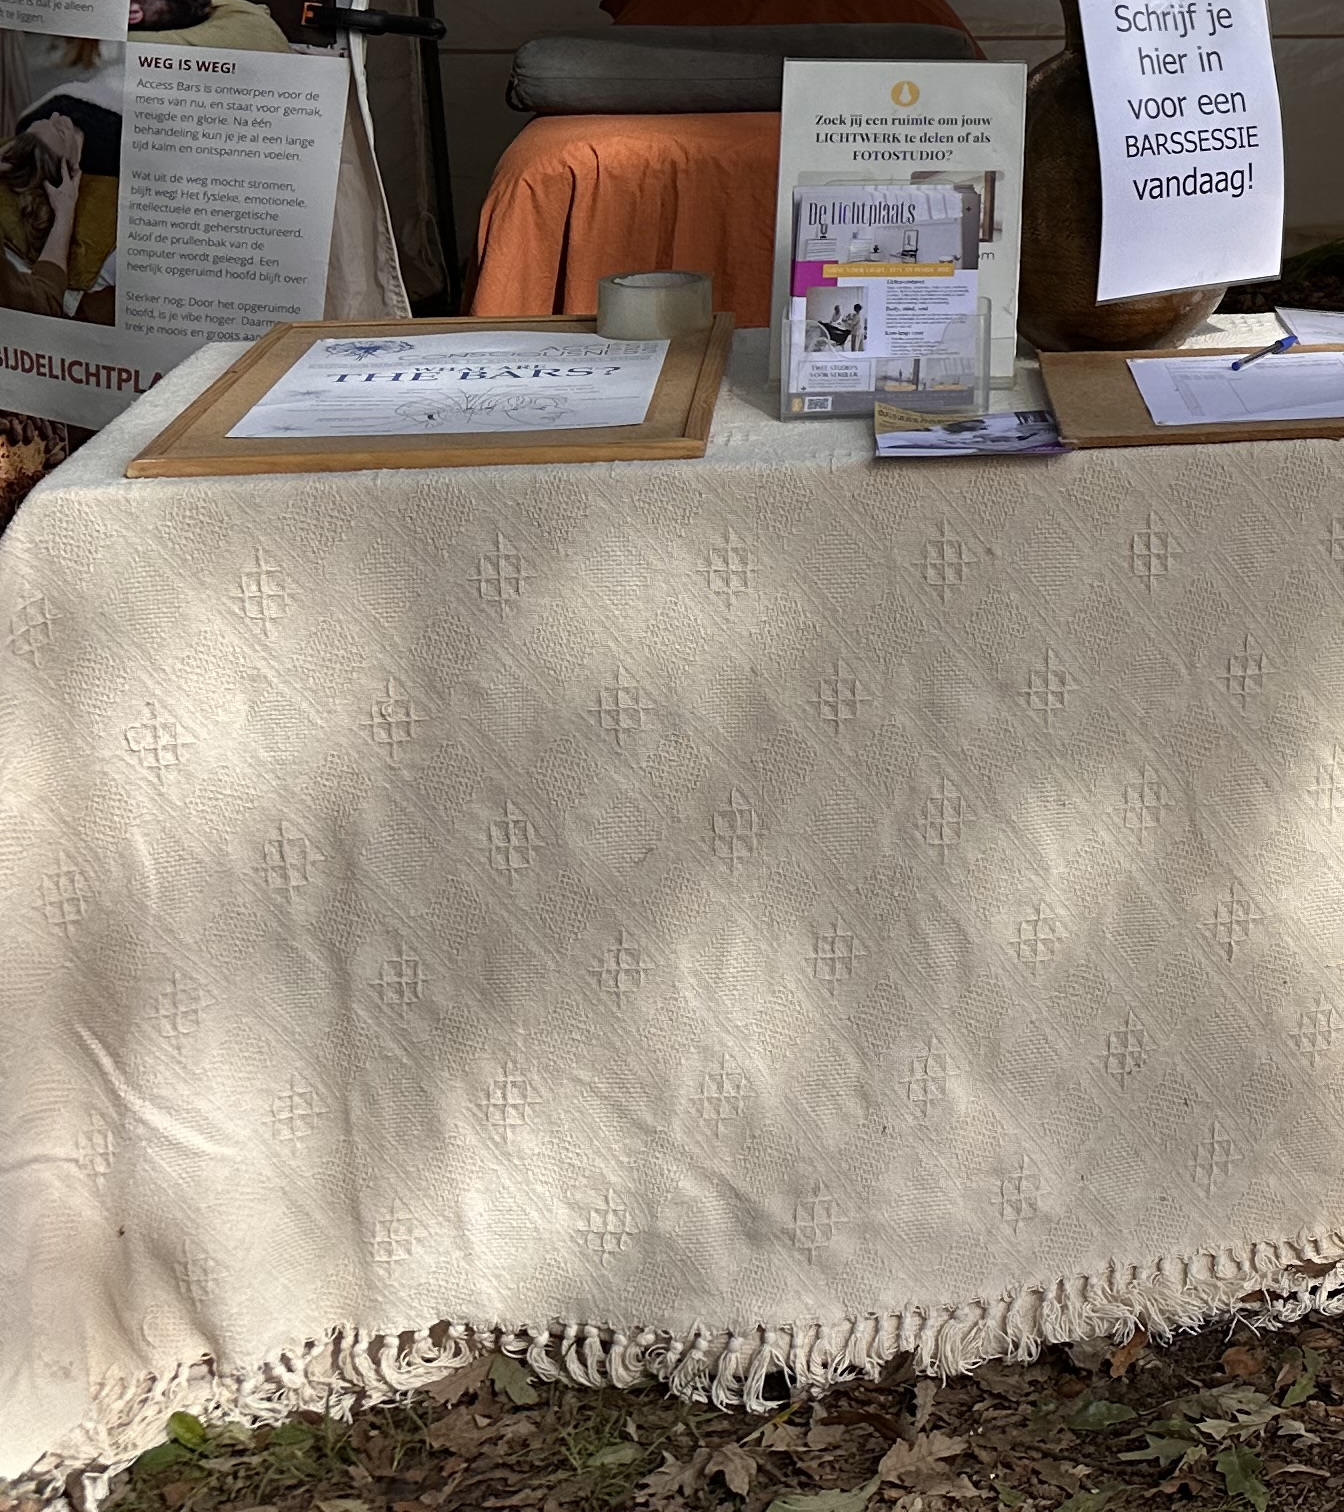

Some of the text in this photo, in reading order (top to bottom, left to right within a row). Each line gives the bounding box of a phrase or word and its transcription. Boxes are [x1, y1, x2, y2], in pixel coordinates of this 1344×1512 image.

[1114, 2, 1233, 37] Schrijf je
[138, 55, 237, 74] WEG IS WEG!
[1138, 46, 1223, 75] hier in
[136, 78, 320, 101] Access Bars is ontworpen voor de
[135, 95, 165, 105] mens
[168, 97, 187, 107] van
[209, 101, 223, 109] en
[226, 102, 253, 112] staat
[256, 104, 281, 113] voor
[1127, 91, 1246, 120] voor een
[815, 114, 992, 128] Zoek jij een ruimte om jouw
[815, 132, 991, 144] LICHTWERK te delen of als
[1125, 125, 1259, 158] BARSSESSIE
[853, 149, 953, 161] FOTOSTUDIO?
[1133, 162, 1253, 200] vandaag!
[808, 202, 827, 226] De
[0, 346, 164, 394] IJDELICHTPL
[327, 365, 622, 383] THE BARS?
